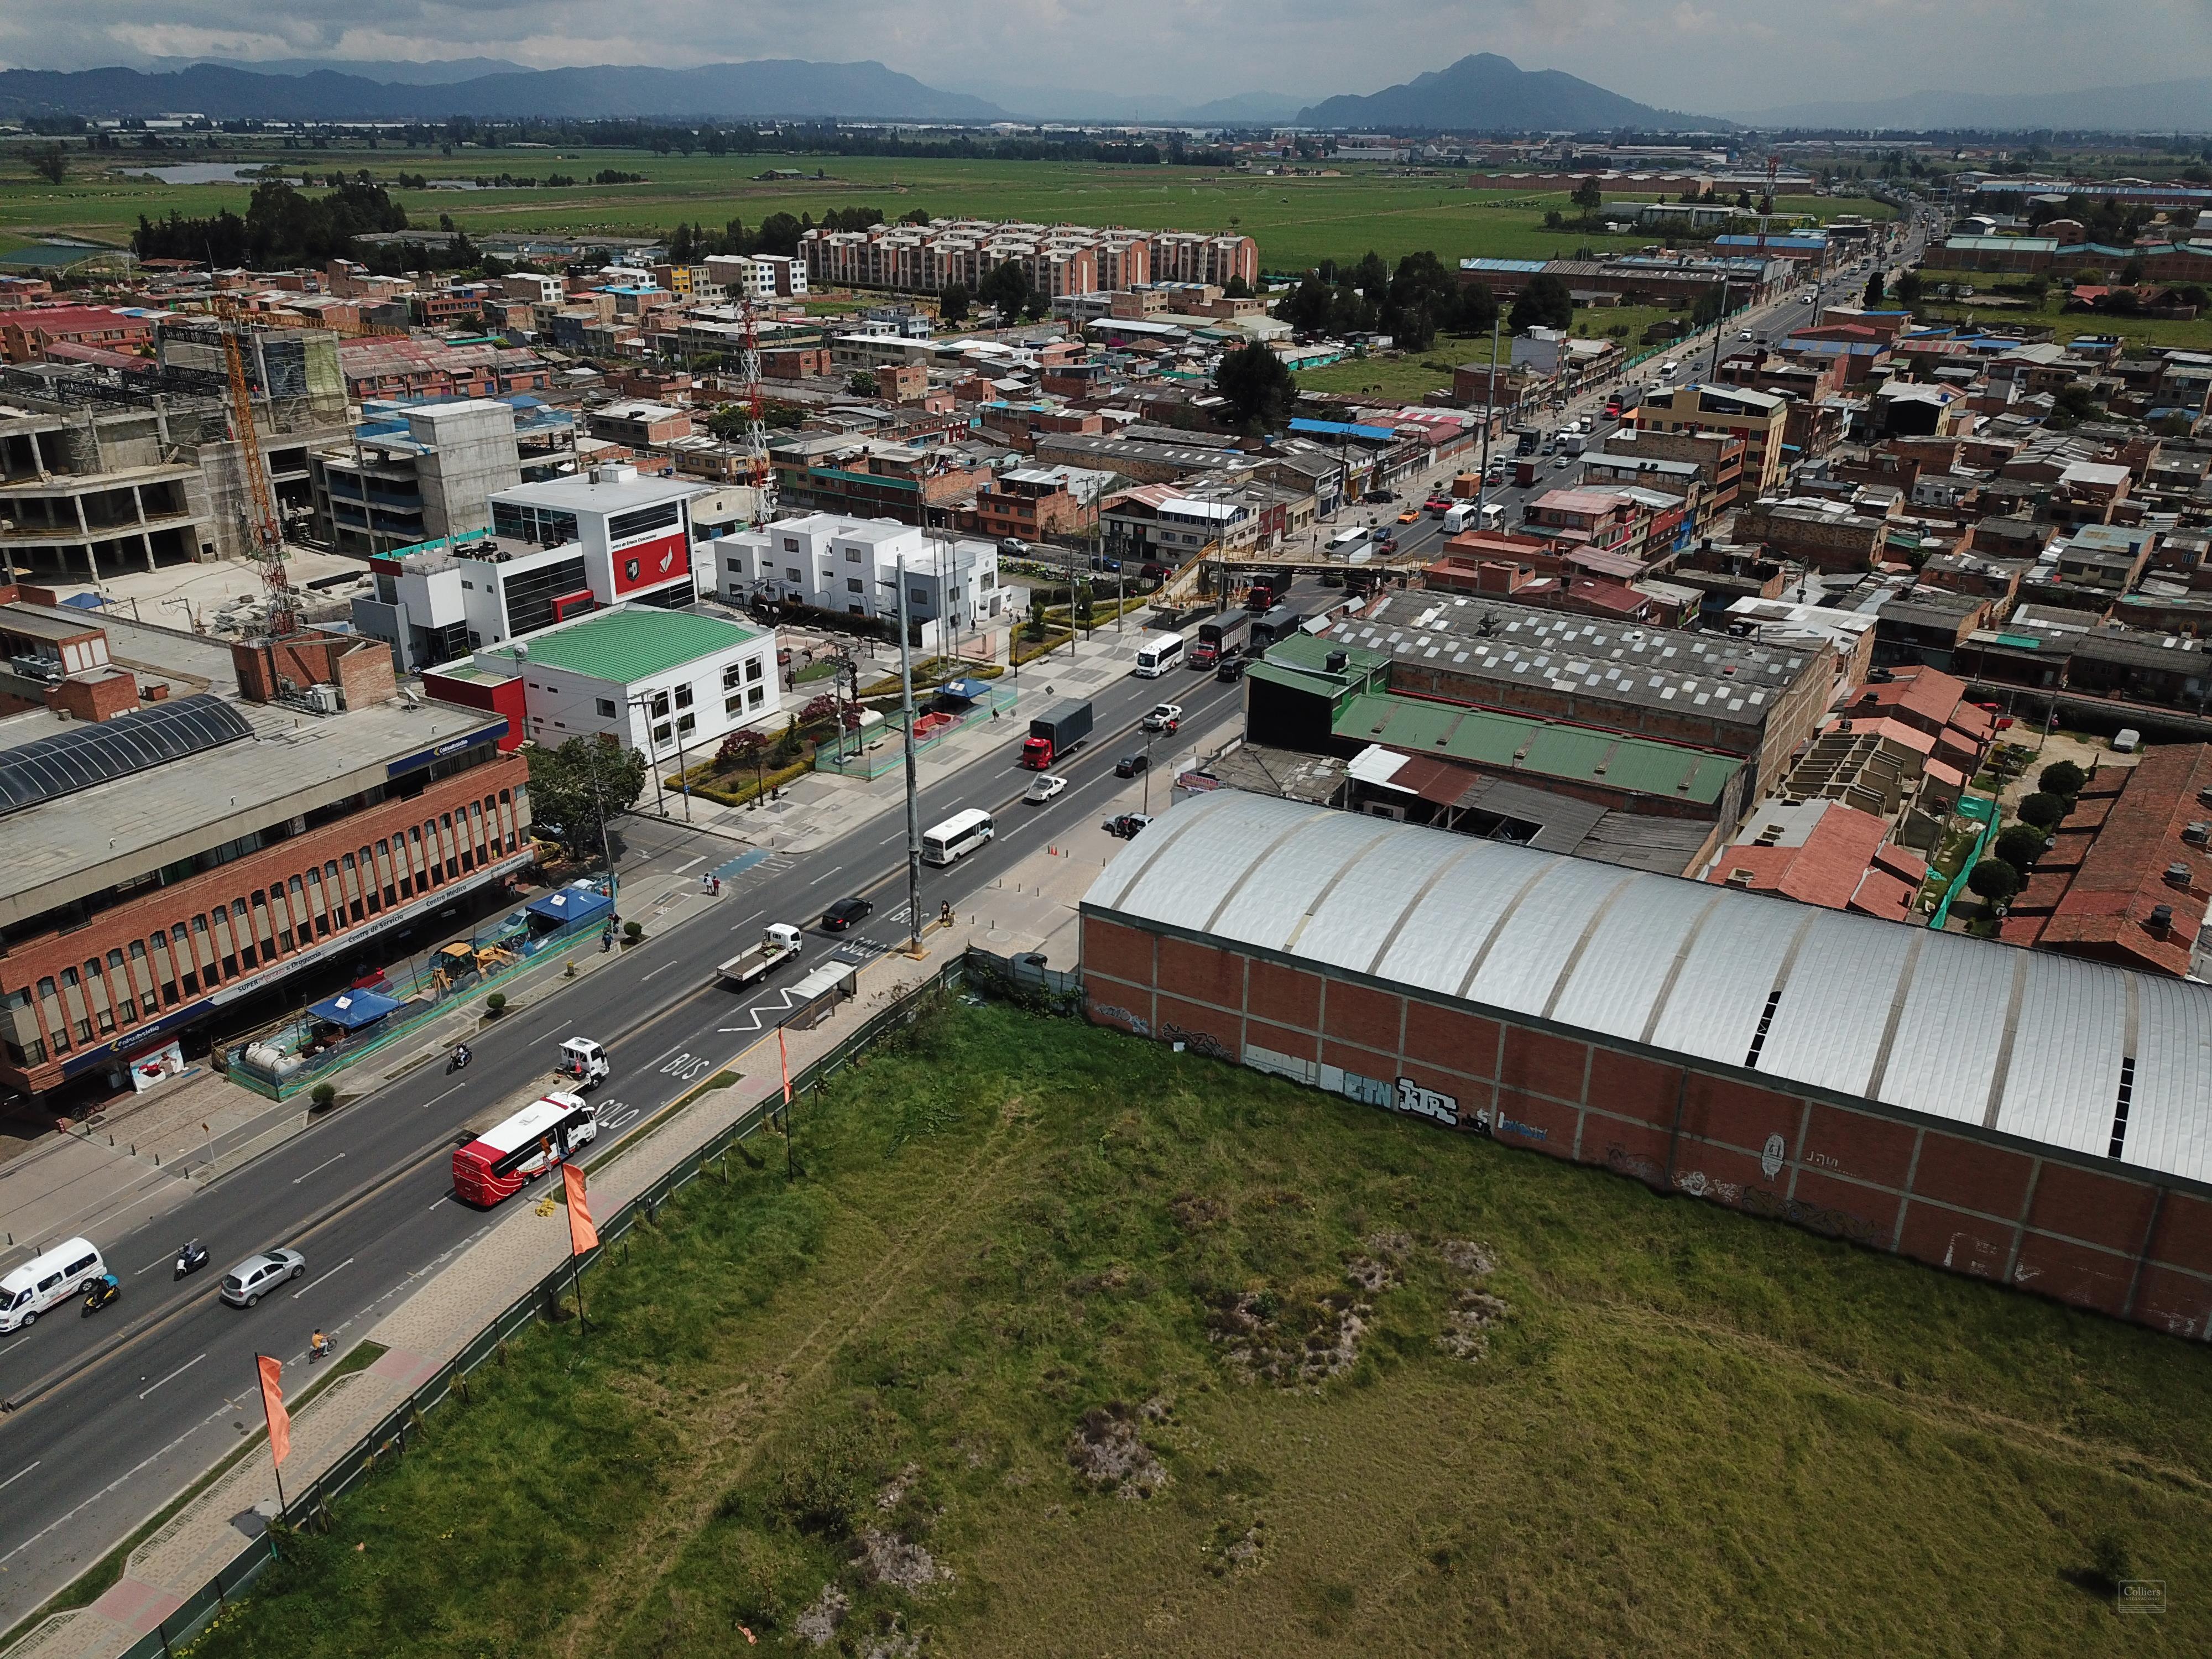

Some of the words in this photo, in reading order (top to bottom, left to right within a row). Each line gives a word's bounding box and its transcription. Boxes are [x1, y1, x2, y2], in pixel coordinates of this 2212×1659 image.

[440, 740, 468, 753] Colsubsidio
[426, 894, 445, 907] Centro
[348, 928, 369, 943] Centro
[379, 914, 403, 928] Servicio
[842, 937, 888, 958] SOLO
[659, 1053, 709, 1079] BUS
[594, 1099, 640, 1129] SOLO
